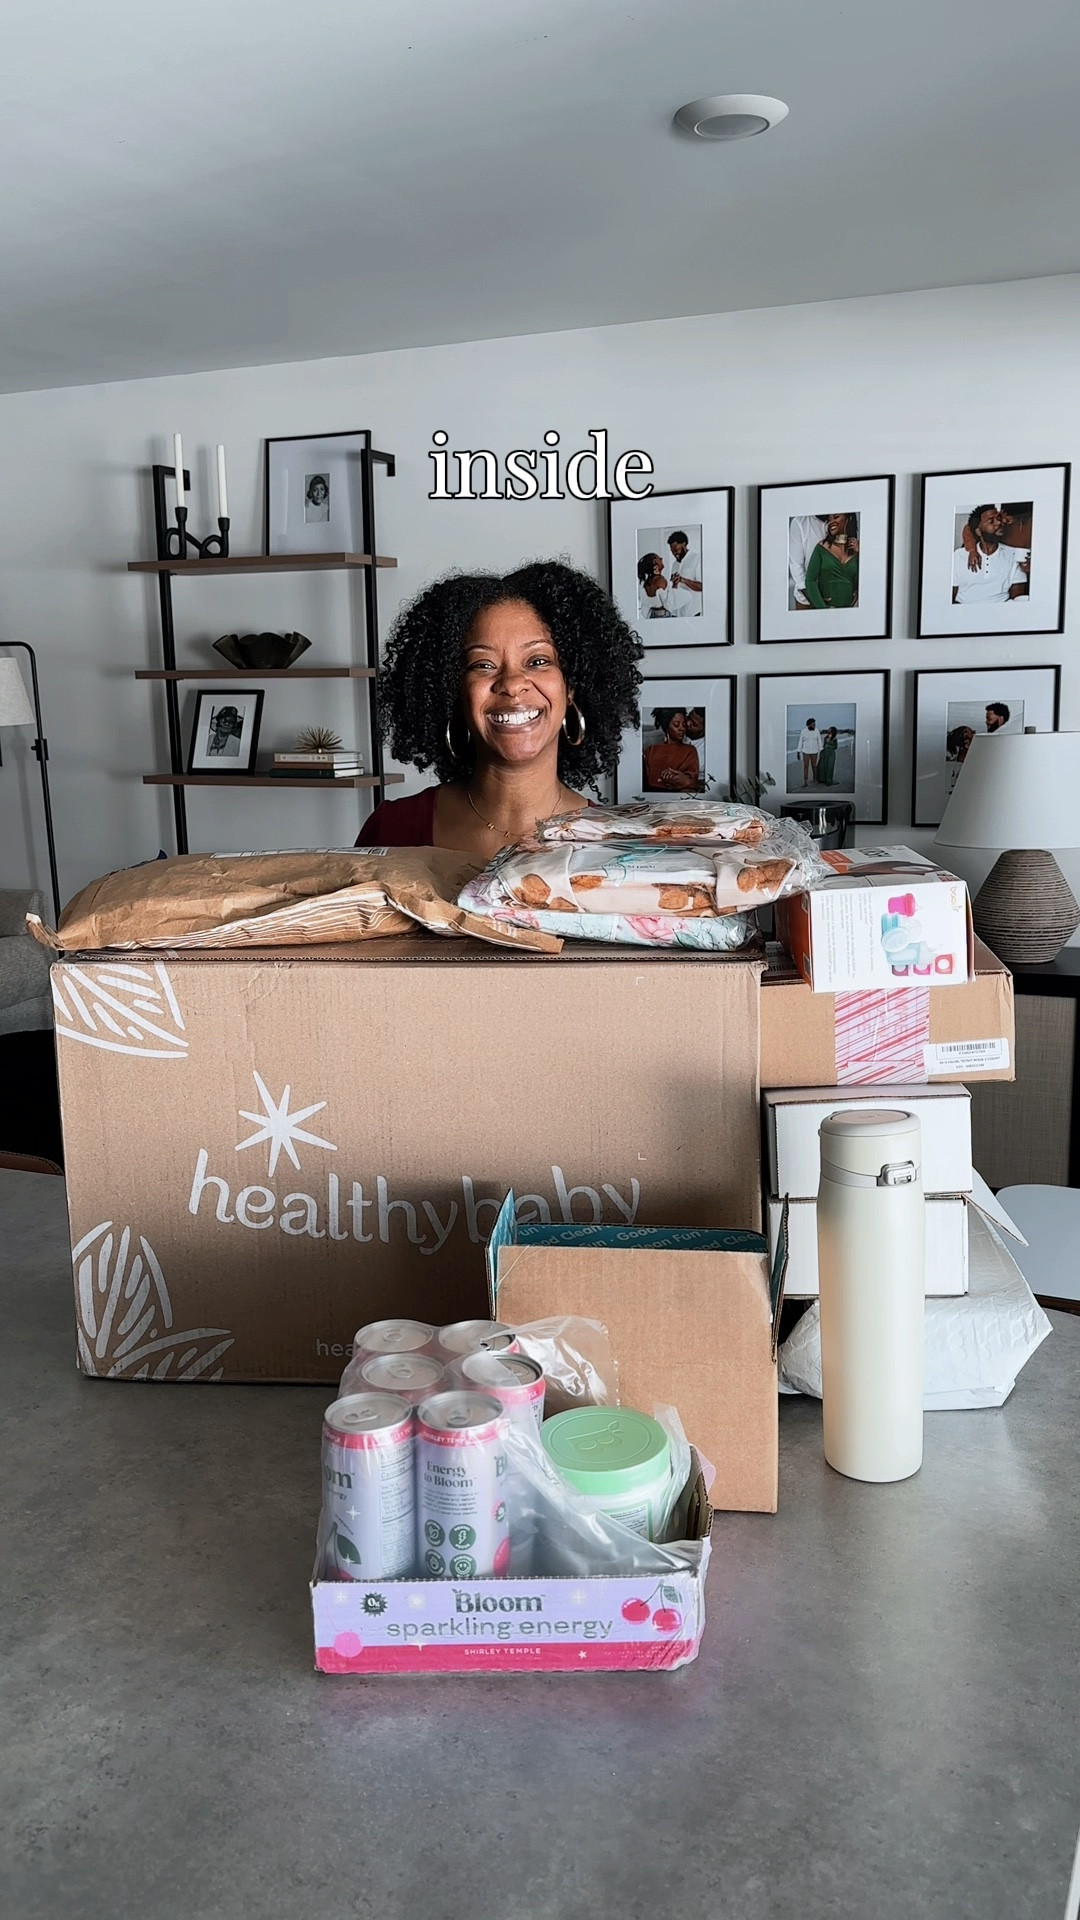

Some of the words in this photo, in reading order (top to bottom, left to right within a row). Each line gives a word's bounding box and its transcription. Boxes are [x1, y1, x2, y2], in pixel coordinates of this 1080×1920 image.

[671, 1230, 702, 1243] Fun
[427, 1460, 467, 1478] Energy
[453, 1589, 544, 1613] Bloom
[386, 1617, 511, 1641] sparkling
[518, 1618, 614, 1639] energy
[464, 1647, 501, 1655] SHIRLEY
[504, 1647, 541, 1655] TEMPLE
